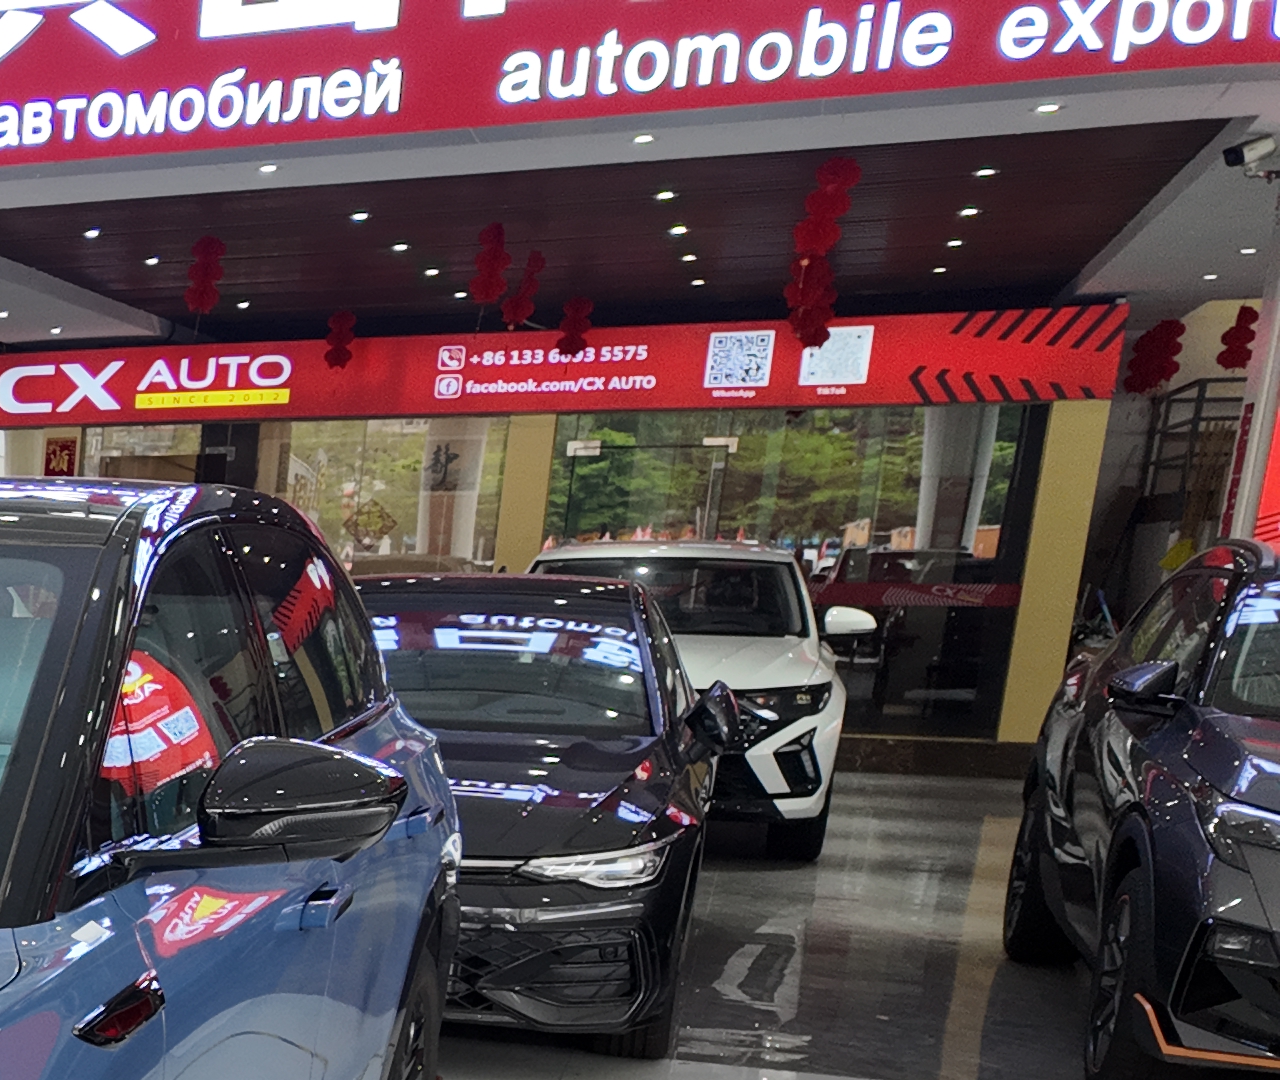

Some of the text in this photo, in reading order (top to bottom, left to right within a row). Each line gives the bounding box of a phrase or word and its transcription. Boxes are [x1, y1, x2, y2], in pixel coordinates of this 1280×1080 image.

[498, 0, 952, 104] automobile
[997, 0, 1280, 62] expor
[469, 350, 506, 366] +86
[509, 348, 545, 366] 133
[599, 344, 649, 362] 5575
[137, 354, 291, 391] AUTO
[465, 374, 657, 394] facebook.com/CX AUTO
[146, 390, 282, 406] SINCE 2012
